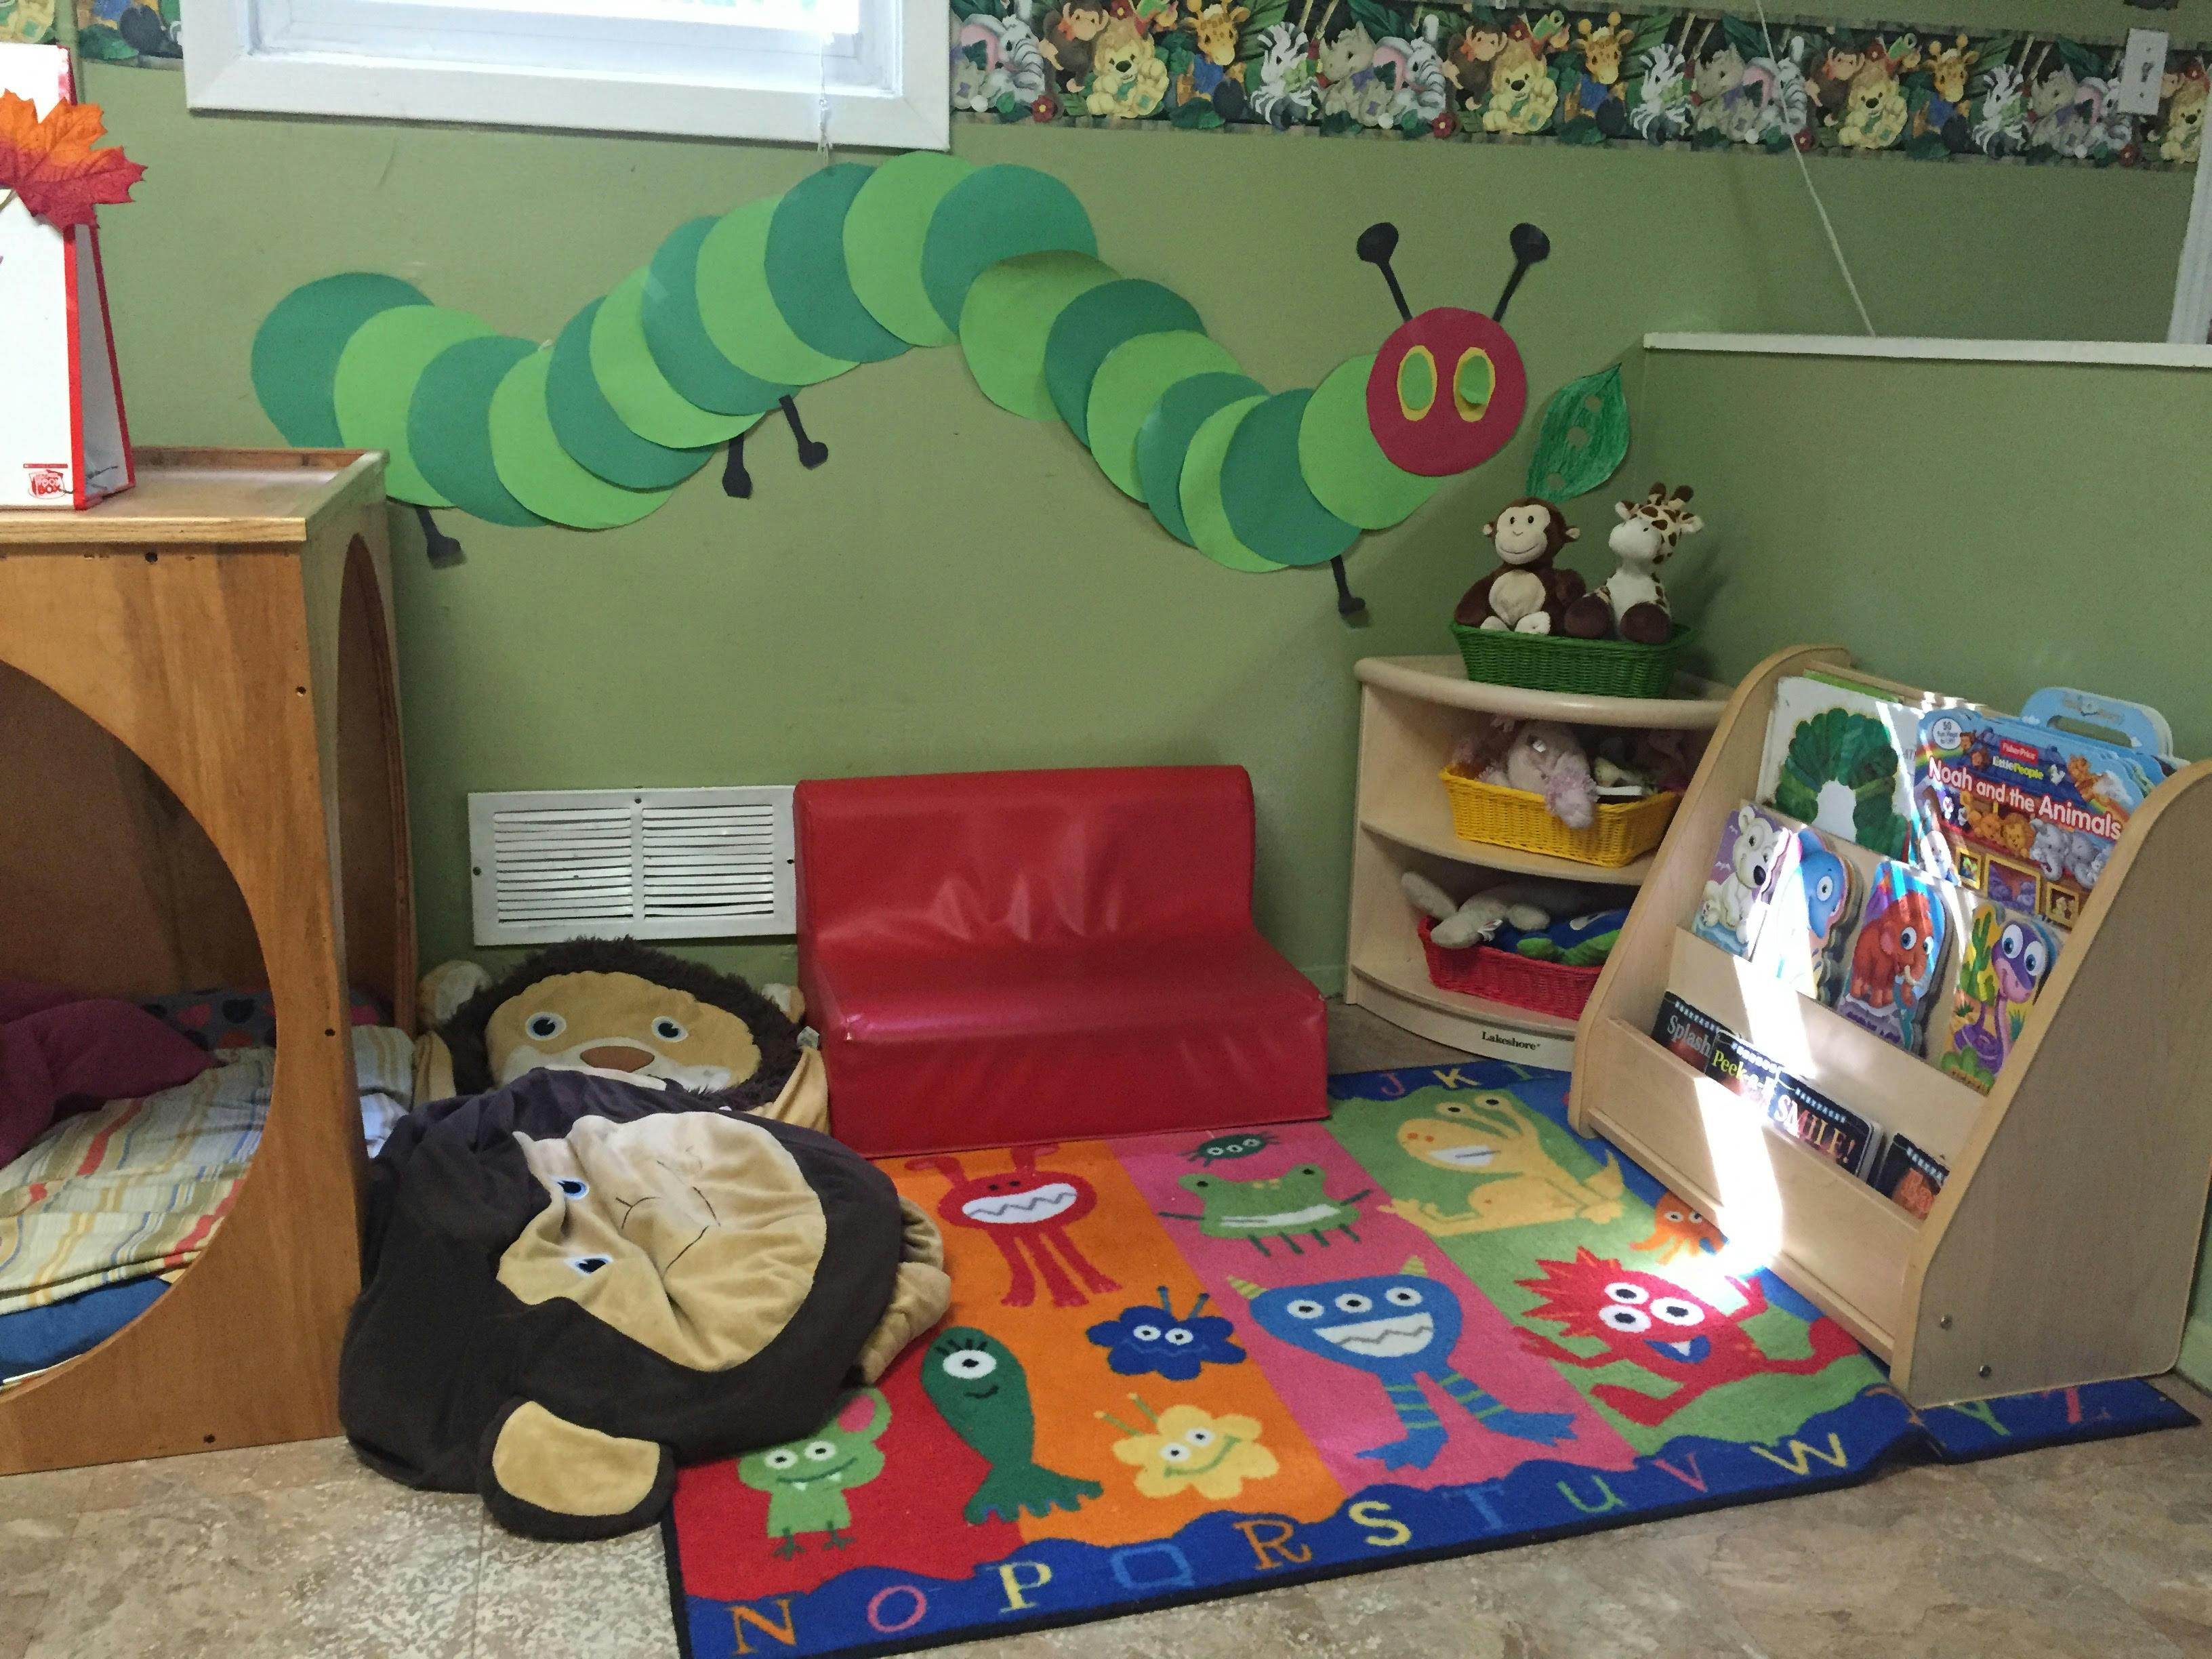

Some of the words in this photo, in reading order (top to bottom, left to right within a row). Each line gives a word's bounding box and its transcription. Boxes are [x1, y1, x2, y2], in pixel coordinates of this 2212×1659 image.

[1929, 756, 1973, 792] Noah
[1976, 780, 2006, 802] and
[2009, 783, 2034, 811] the
[2039, 795, 2122, 841] Animals
[1482, 1031, 1537, 1050] Lakeshore
[1667, 1015, 1712, 1058] Splash
[1378, 1073, 1405, 1096] J
[1433, 1069, 1482, 1089] K
[1774, 1094, 1856, 1164] SMILE!
[727, 1596, 796, 1655] N
[867, 1585, 926, 1632] O
[987, 1561, 1052, 1614] P
[1233, 1519, 1311, 1570] R
[1349, 1500, 1411, 1547] S
[1652, 1453, 1708, 1492] V
[1750, 1432, 1848, 1476] W
